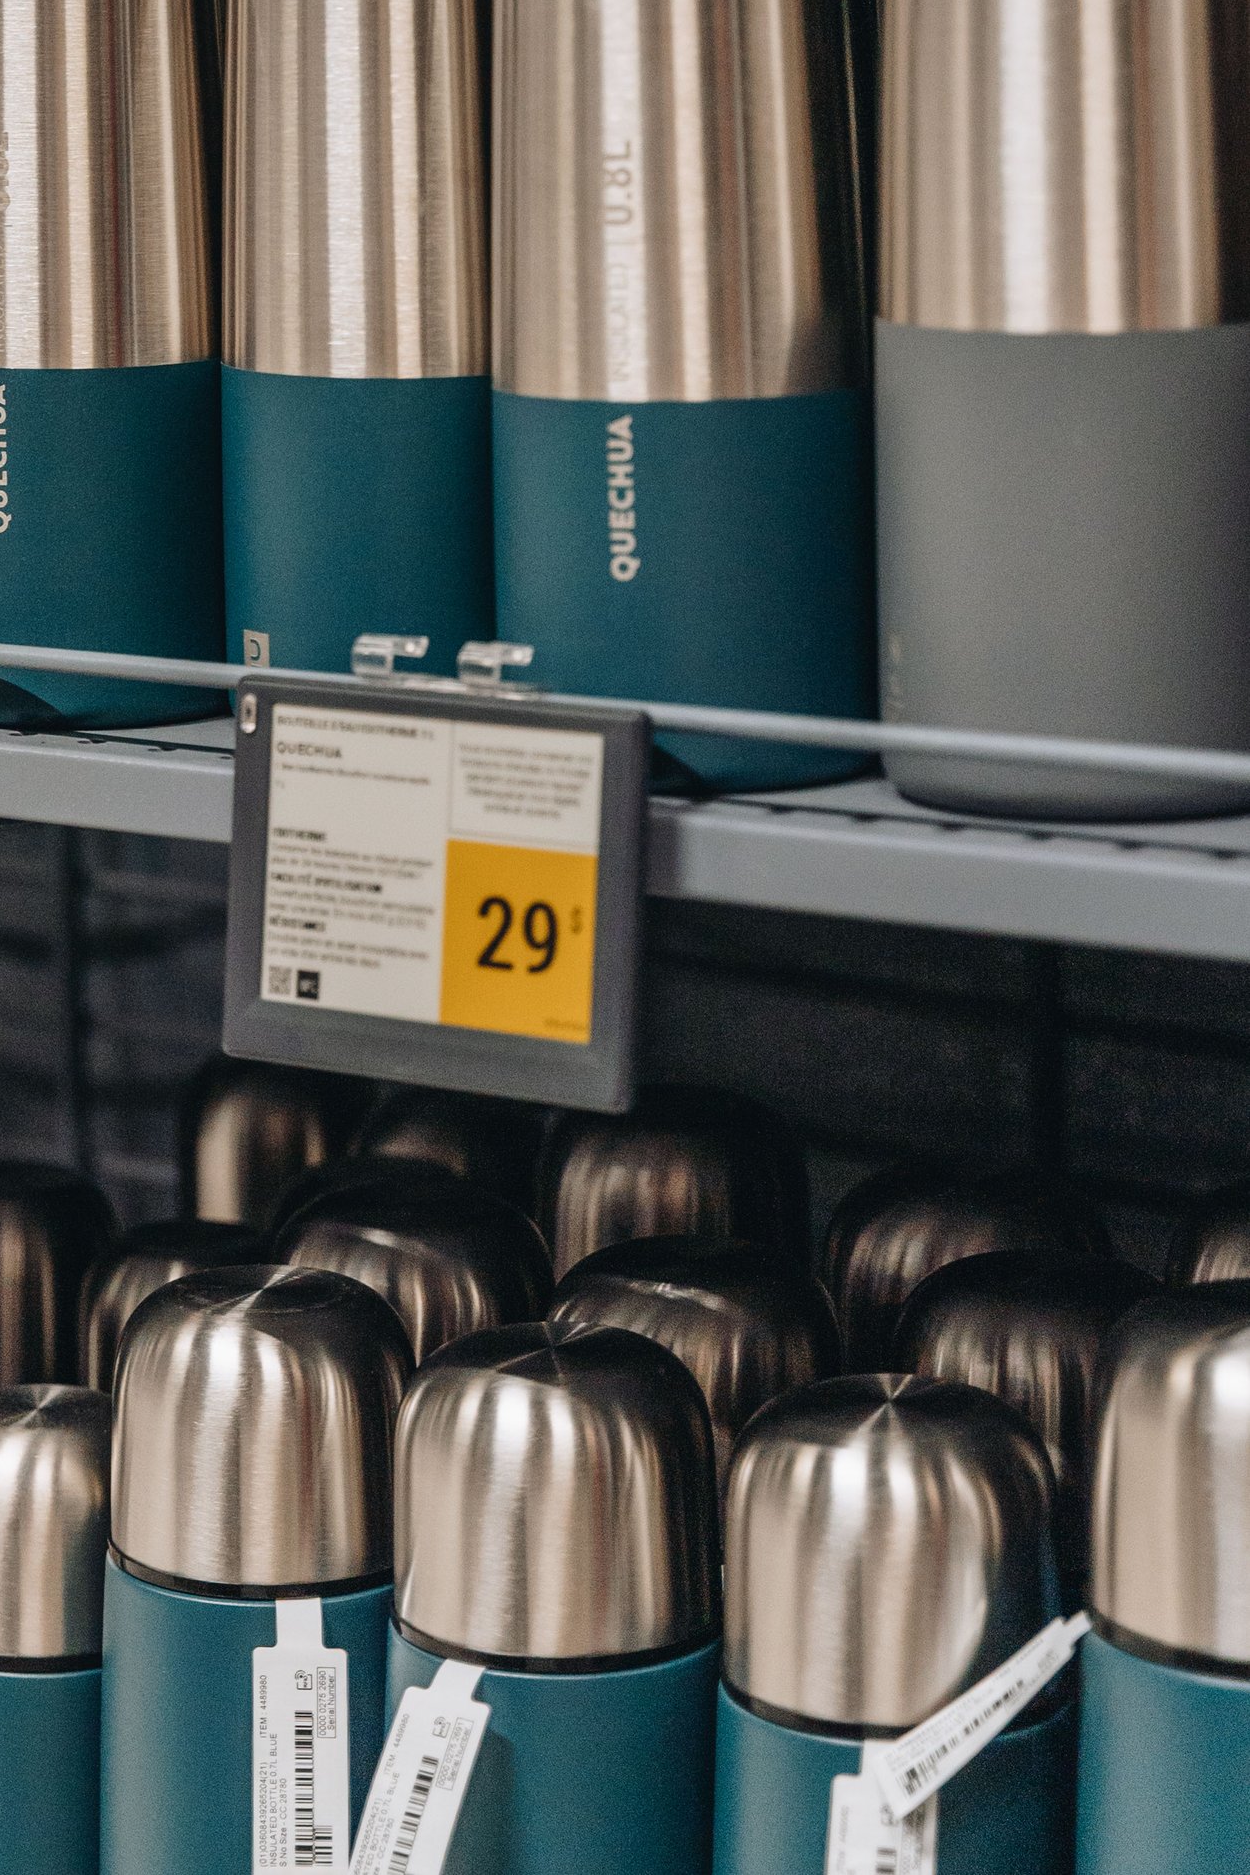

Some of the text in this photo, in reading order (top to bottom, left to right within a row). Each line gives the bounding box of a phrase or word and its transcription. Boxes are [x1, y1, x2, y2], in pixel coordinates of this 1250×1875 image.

[606, 415, 636, 583] QUECHUA
[276, 741, 342, 759] QUECHUA
[476, 891, 559, 977] 29
[259, 1674, 268, 1710] 4489980
[319, 1670, 327, 1736] 0000 0275 2690
[327, 1674, 335, 1730] Serial Number
[259, 1717, 268, 1739] ITEM
[385, 1713, 409, 1774] ITEM 4489980
[279, 1778, 287, 1804] 28780
[439, 1765, 449, 1785] 0000
[269, 1733, 278, 1867] INSULATED BOTTLE 0.7L BLUE
[279, 1805, 287, 1819] CC
[370, 1816, 385, 1850] BOTTLE
[388, 1771, 399, 1794] BLUE
[279, 1827, 287, 1845] Size
[279, 1846, 287, 1859] No
